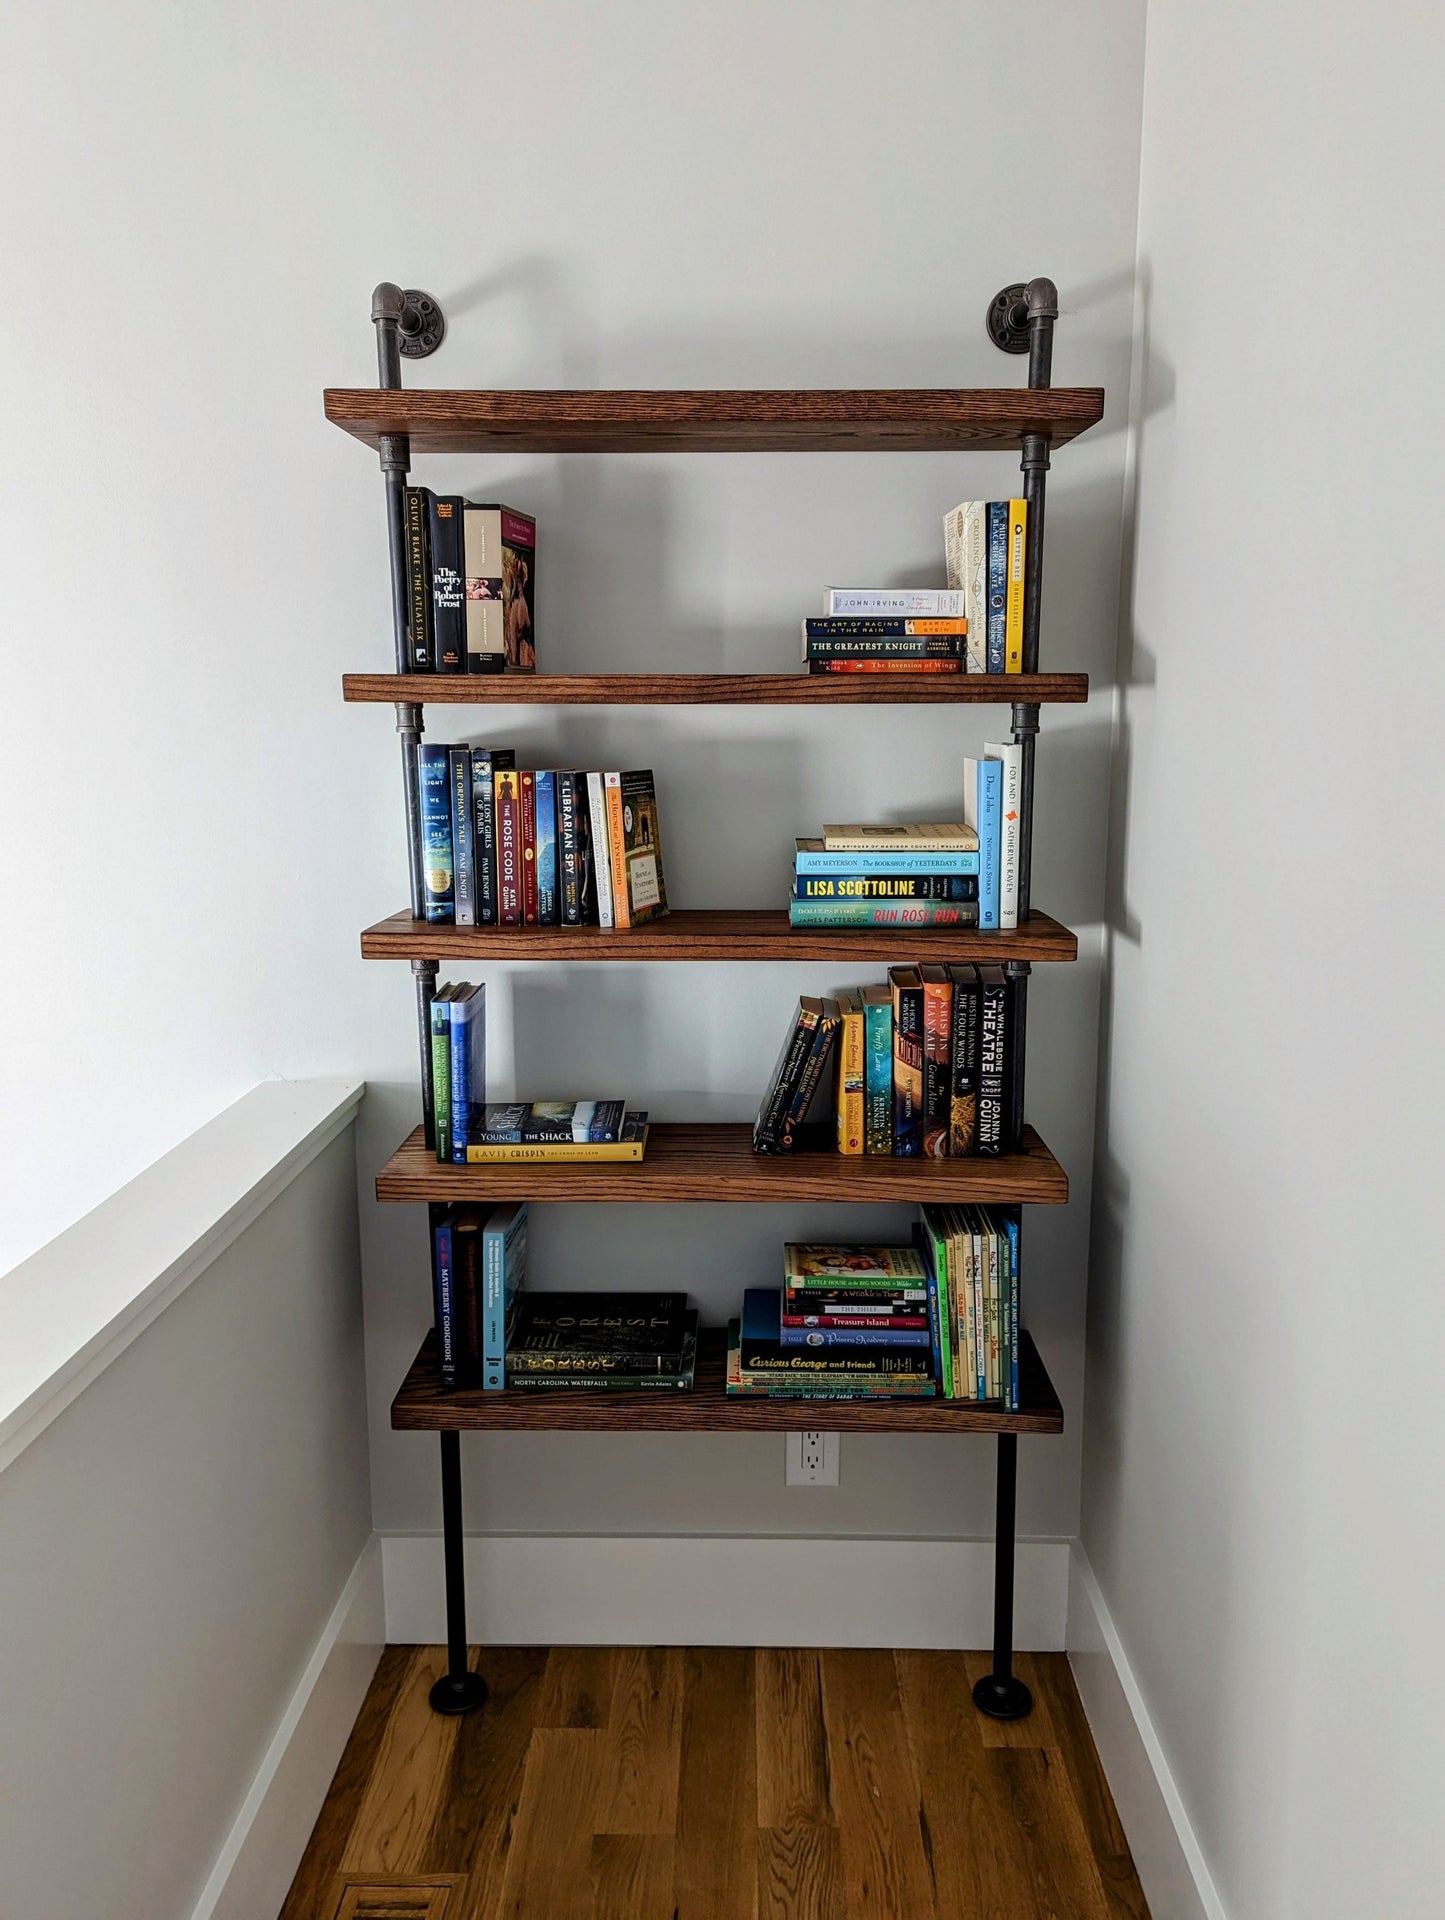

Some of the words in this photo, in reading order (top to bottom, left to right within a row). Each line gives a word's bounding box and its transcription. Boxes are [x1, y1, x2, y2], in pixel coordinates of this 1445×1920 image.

[411, 498, 419, 531] OLIVIE
[412, 536, 420, 565] BLAKE
[998, 523, 1006, 564] MIDNIGHT
[434, 575, 462, 585] Poetry
[438, 568, 456, 576] The
[434, 591, 464, 600] Robert
[443, 583, 452, 592] of
[415, 595, 423, 623] ATLAS
[438, 600, 460, 608] Frost
[416, 626, 424, 640] SIX
[885, 642, 922, 650] KNIGHT
[986, 775, 995, 793] Dear
[457, 782, 465, 821] ORPHAN'S
[477, 799, 483, 810] OF
[985, 795, 994, 813] John
[562, 788, 573, 848] LIBRARIAN
[503, 819, 513, 848] ROSE
[504, 851, 513, 881] CODE
[565, 853, 574, 874] SPY
[614, 840, 622, 885] TYNEFORD
[907, 861, 913, 869] of
[806, 882, 834, 897] LISA
[838, 882, 915, 897] SCOTTOLINE
[1006, 869, 1014, 893] RAVEN
[874, 910, 897, 923] RUN
[901, 910, 929, 923] ROSE
[934, 910, 959, 923] RUN
[959, 994, 967, 1009] THE
[968, 995, 976, 1027] KRISTIN
[824, 1031, 833, 1042] THE
[927, 1001, 936, 1051] HANNAH
[939, 1001, 948, 1050] KRISTIN
[958, 1013, 967, 1037] FOUR
[982, 1000, 996, 1072] THEATRE
[874, 1027, 884, 1051] Firefly
[967, 1031, 975, 1068] HANNAH
[996, 1013, 1005, 1072] WHALEBONE
[812, 1042, 830, 1077] DICTIONARY
[875, 1053, 883, 1072] Lane
[957, 1039, 966, 1069] WINDS
[799, 1066, 814, 1093] WILLIAMS
[810, 1078, 817, 1086] OF
[928, 1064, 937, 1088] Great
[804, 1086, 815, 1101] LOST
[928, 1090, 937, 1116] Alone
[490, 1113, 506, 1122] THE
[497, 1105, 526, 1129] SHACK
[796, 1102, 808, 1123] WORDS
[980, 1099, 991, 1142] QUINN
[991, 1100, 1001, 1141] JOANNA
[481, 1133, 511, 1141] YOUNG
[540, 1132, 572, 1141] SHACK
[510, 1150, 545, 1158] CRISPIN
[441, 1269, 450, 1313] MAYBERRY
[832, 1318, 865, 1326] Treasure
[867, 1318, 889, 1326] Island
[443, 1315, 452, 1361] COOKBOOK
[826, 1332, 855, 1345] Princess
[855, 1335, 888, 1346] Academy
[749, 1356, 789, 1367] Curious
[791, 1357, 827, 1370] George
[847, 1361, 876, 1369] Friends
